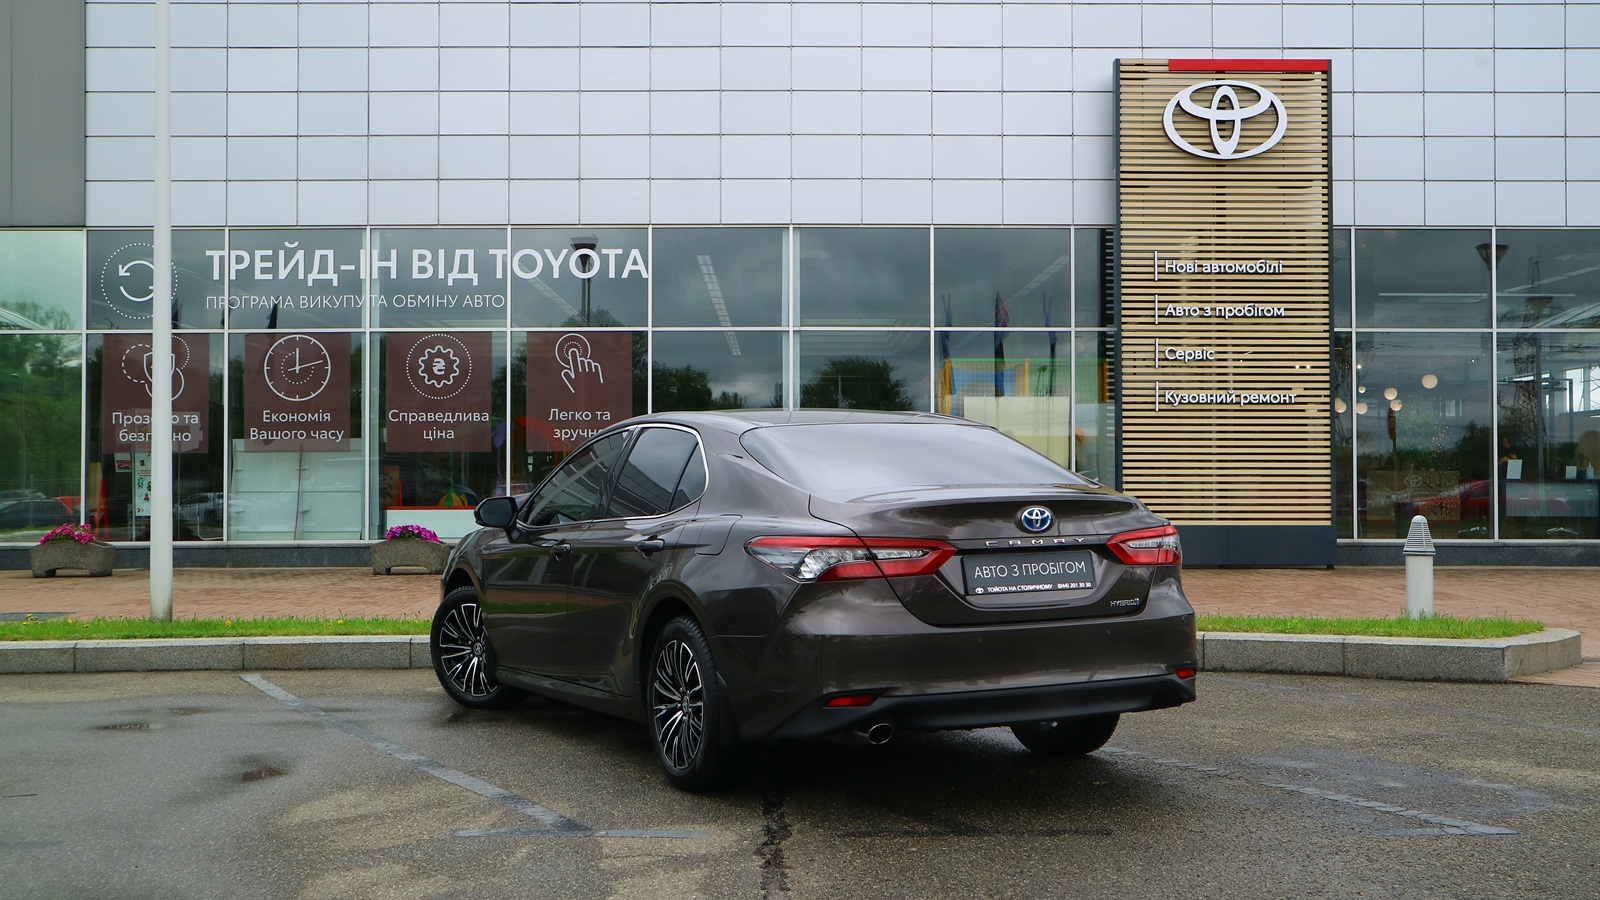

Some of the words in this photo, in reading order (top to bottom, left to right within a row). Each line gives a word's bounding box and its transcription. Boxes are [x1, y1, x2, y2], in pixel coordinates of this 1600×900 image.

[205, 241, 397, 287] ТРЕЙД-ІН
[412, 249, 478, 286] ВІД
[488, 248, 648, 279] TOYOTA
[1164, 260, 1198, 273] Нові
[1202, 260, 1283, 273] автомобілі
[206, 296, 294, 309] ПРОГРАМА
[300, 295, 365, 309] ВИКУПУ
[370, 295, 388, 308] ТА
[392, 294, 458, 308] ОБМІНУ
[462, 294, 505, 308] АВТО
[1164, 304, 1200, 317] Авто
[1204, 308, 1211, 317] з
[1215, 304, 1285, 319] пробігом
[1164, 347, 1215, 362] Сервіс
[1164, 390, 1236, 406] Кузовний
[1240, 393, 1297, 407] ремонт
[112, 412, 179, 427] Прозо
[183, 414, 199, 424] та
[263, 410, 331, 422] Економія
[388, 409, 490, 424] Справедлива
[548, 408, 592, 421] Легко
[595, 411, 611, 421] та
[119, 428, 191, 442] безпно
[250, 428, 306, 440] Вашого
[310, 430, 345, 442] часу
[423, 427, 455, 441] ціна
[553, 428, 604, 441] зручн
[985, 537, 1086, 547] CAMRY
[974, 565, 1008, 579] АВТО
[1022, 561, 1086, 576] ПРОБІГОМ
[1017, 584, 1053, 592] СТОЛИЧНОМУ
[1110, 599, 1135, 607] HYBRID
